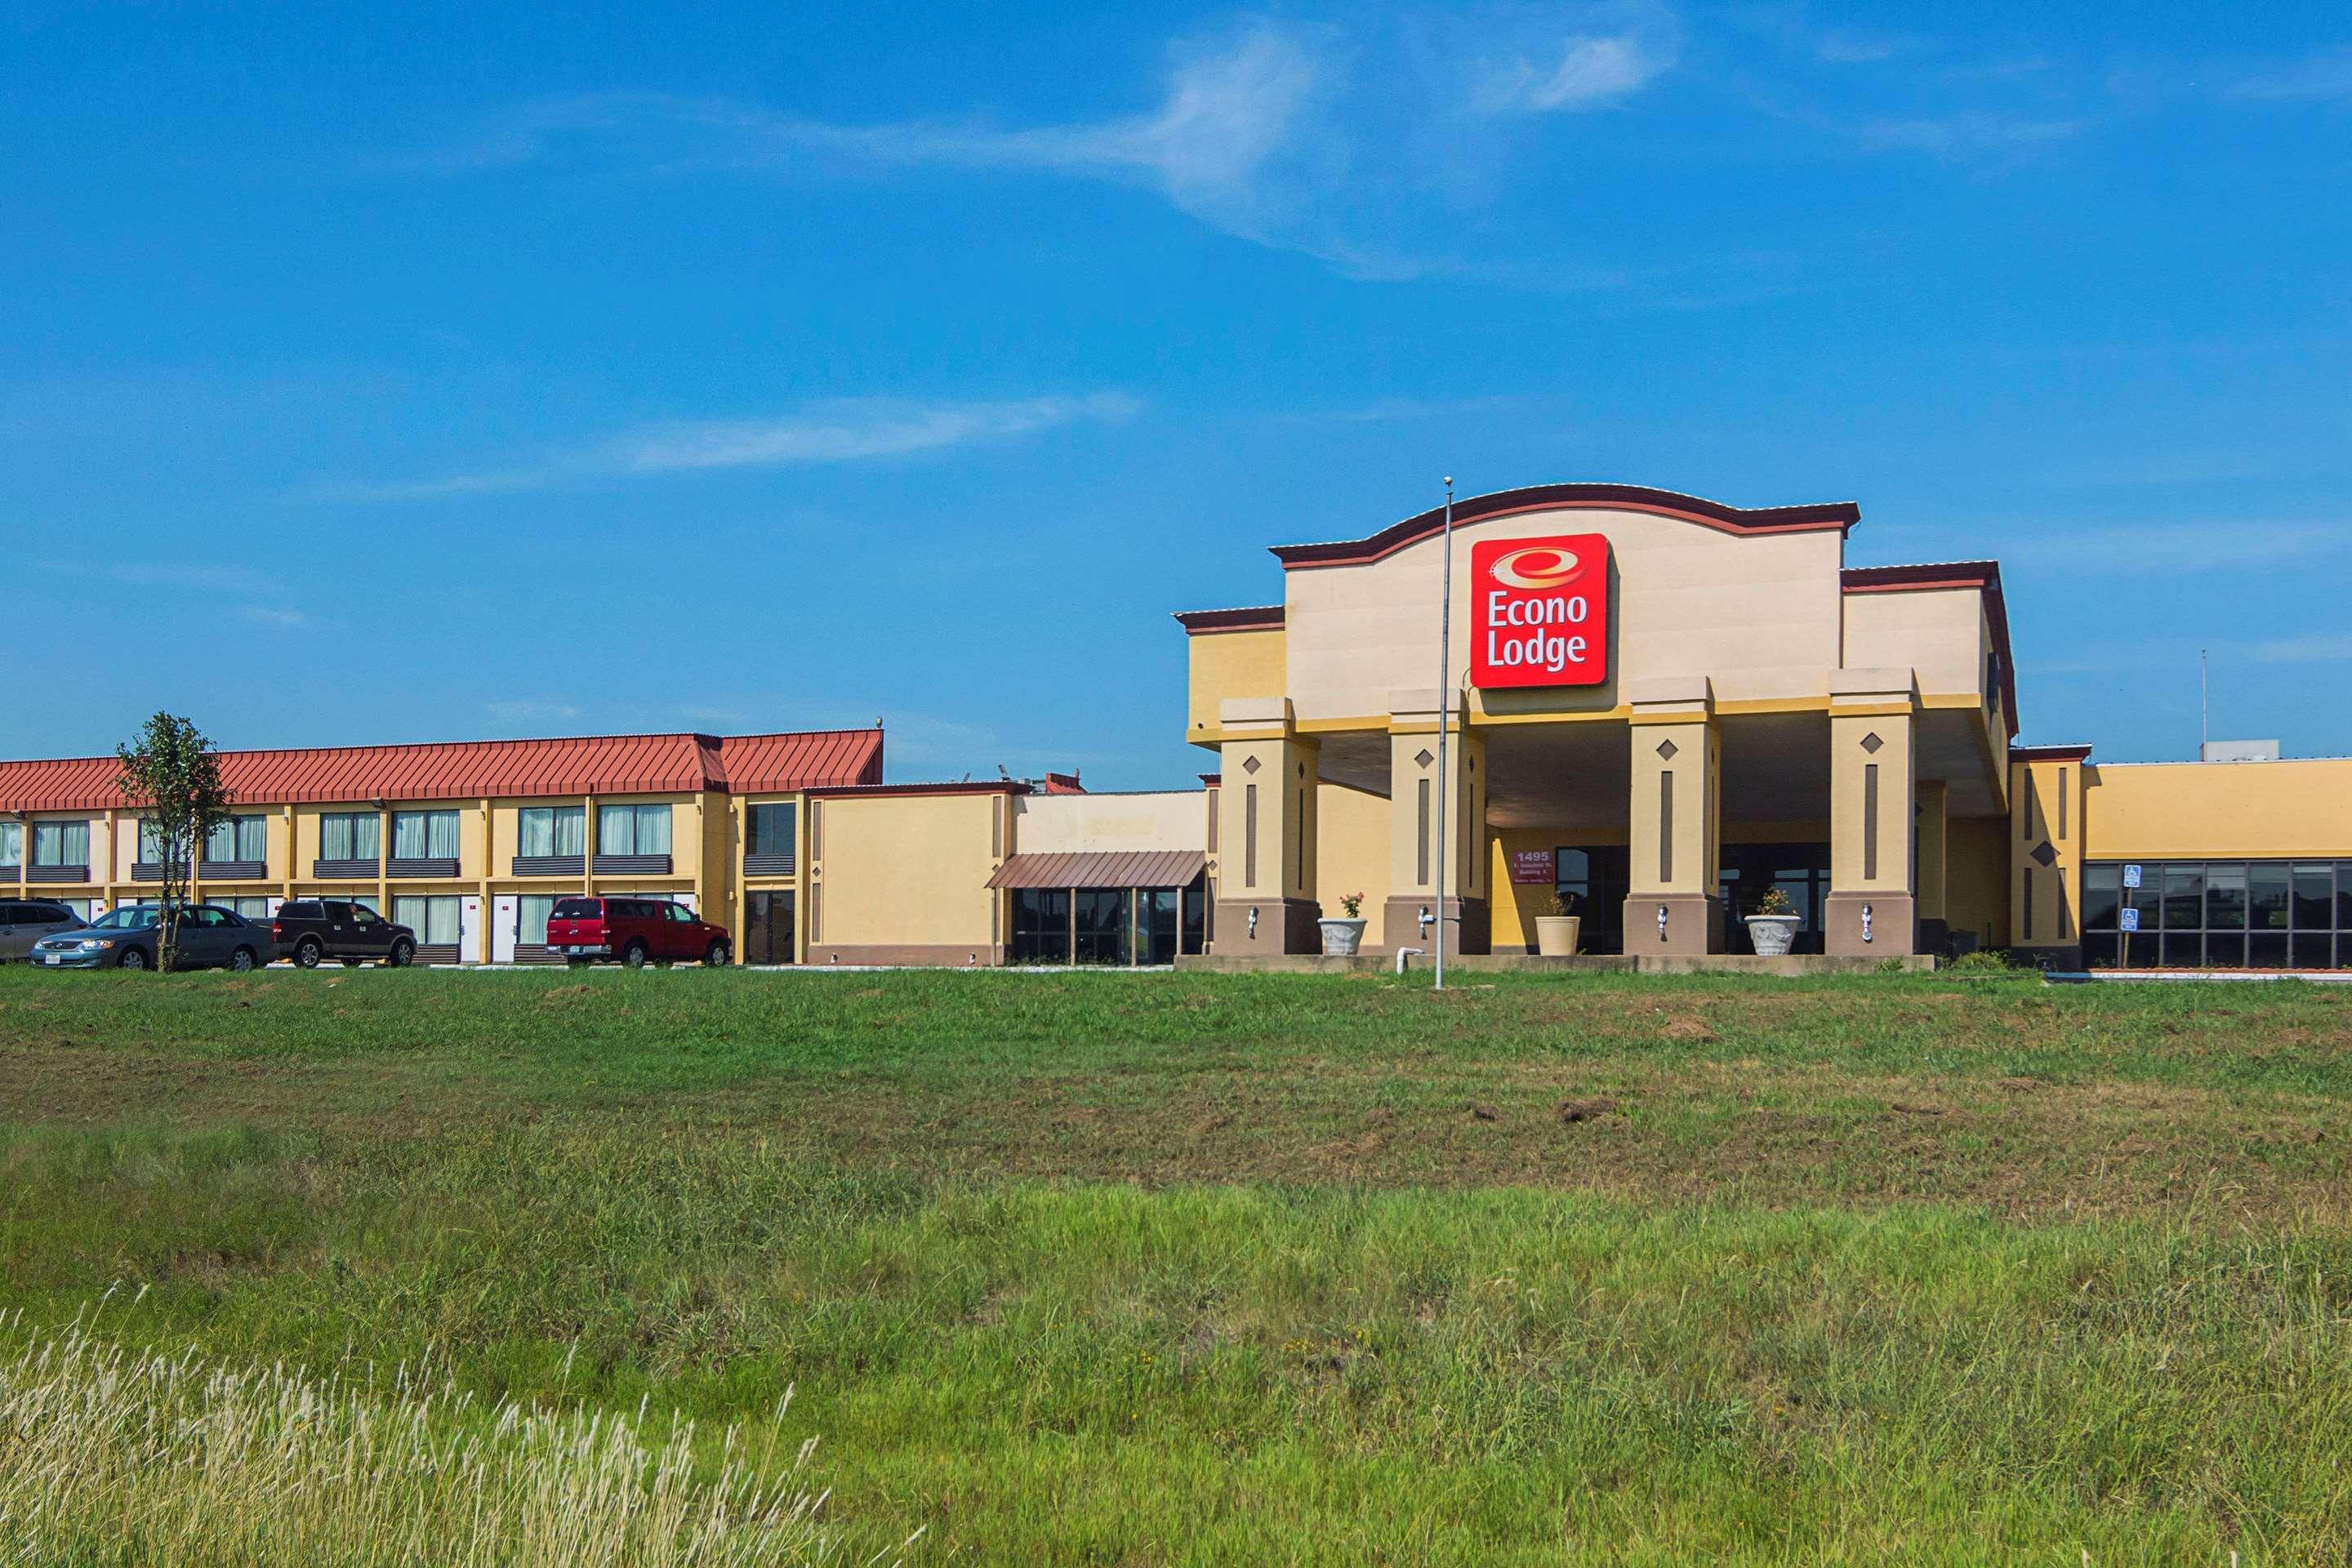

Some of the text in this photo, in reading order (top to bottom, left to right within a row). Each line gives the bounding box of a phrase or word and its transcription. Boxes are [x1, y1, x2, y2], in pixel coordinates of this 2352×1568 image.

[1488, 590, 1587, 627] Econo
[1488, 628, 1586, 672] Lodge
[1517, 851, 1549, 862] 1495
